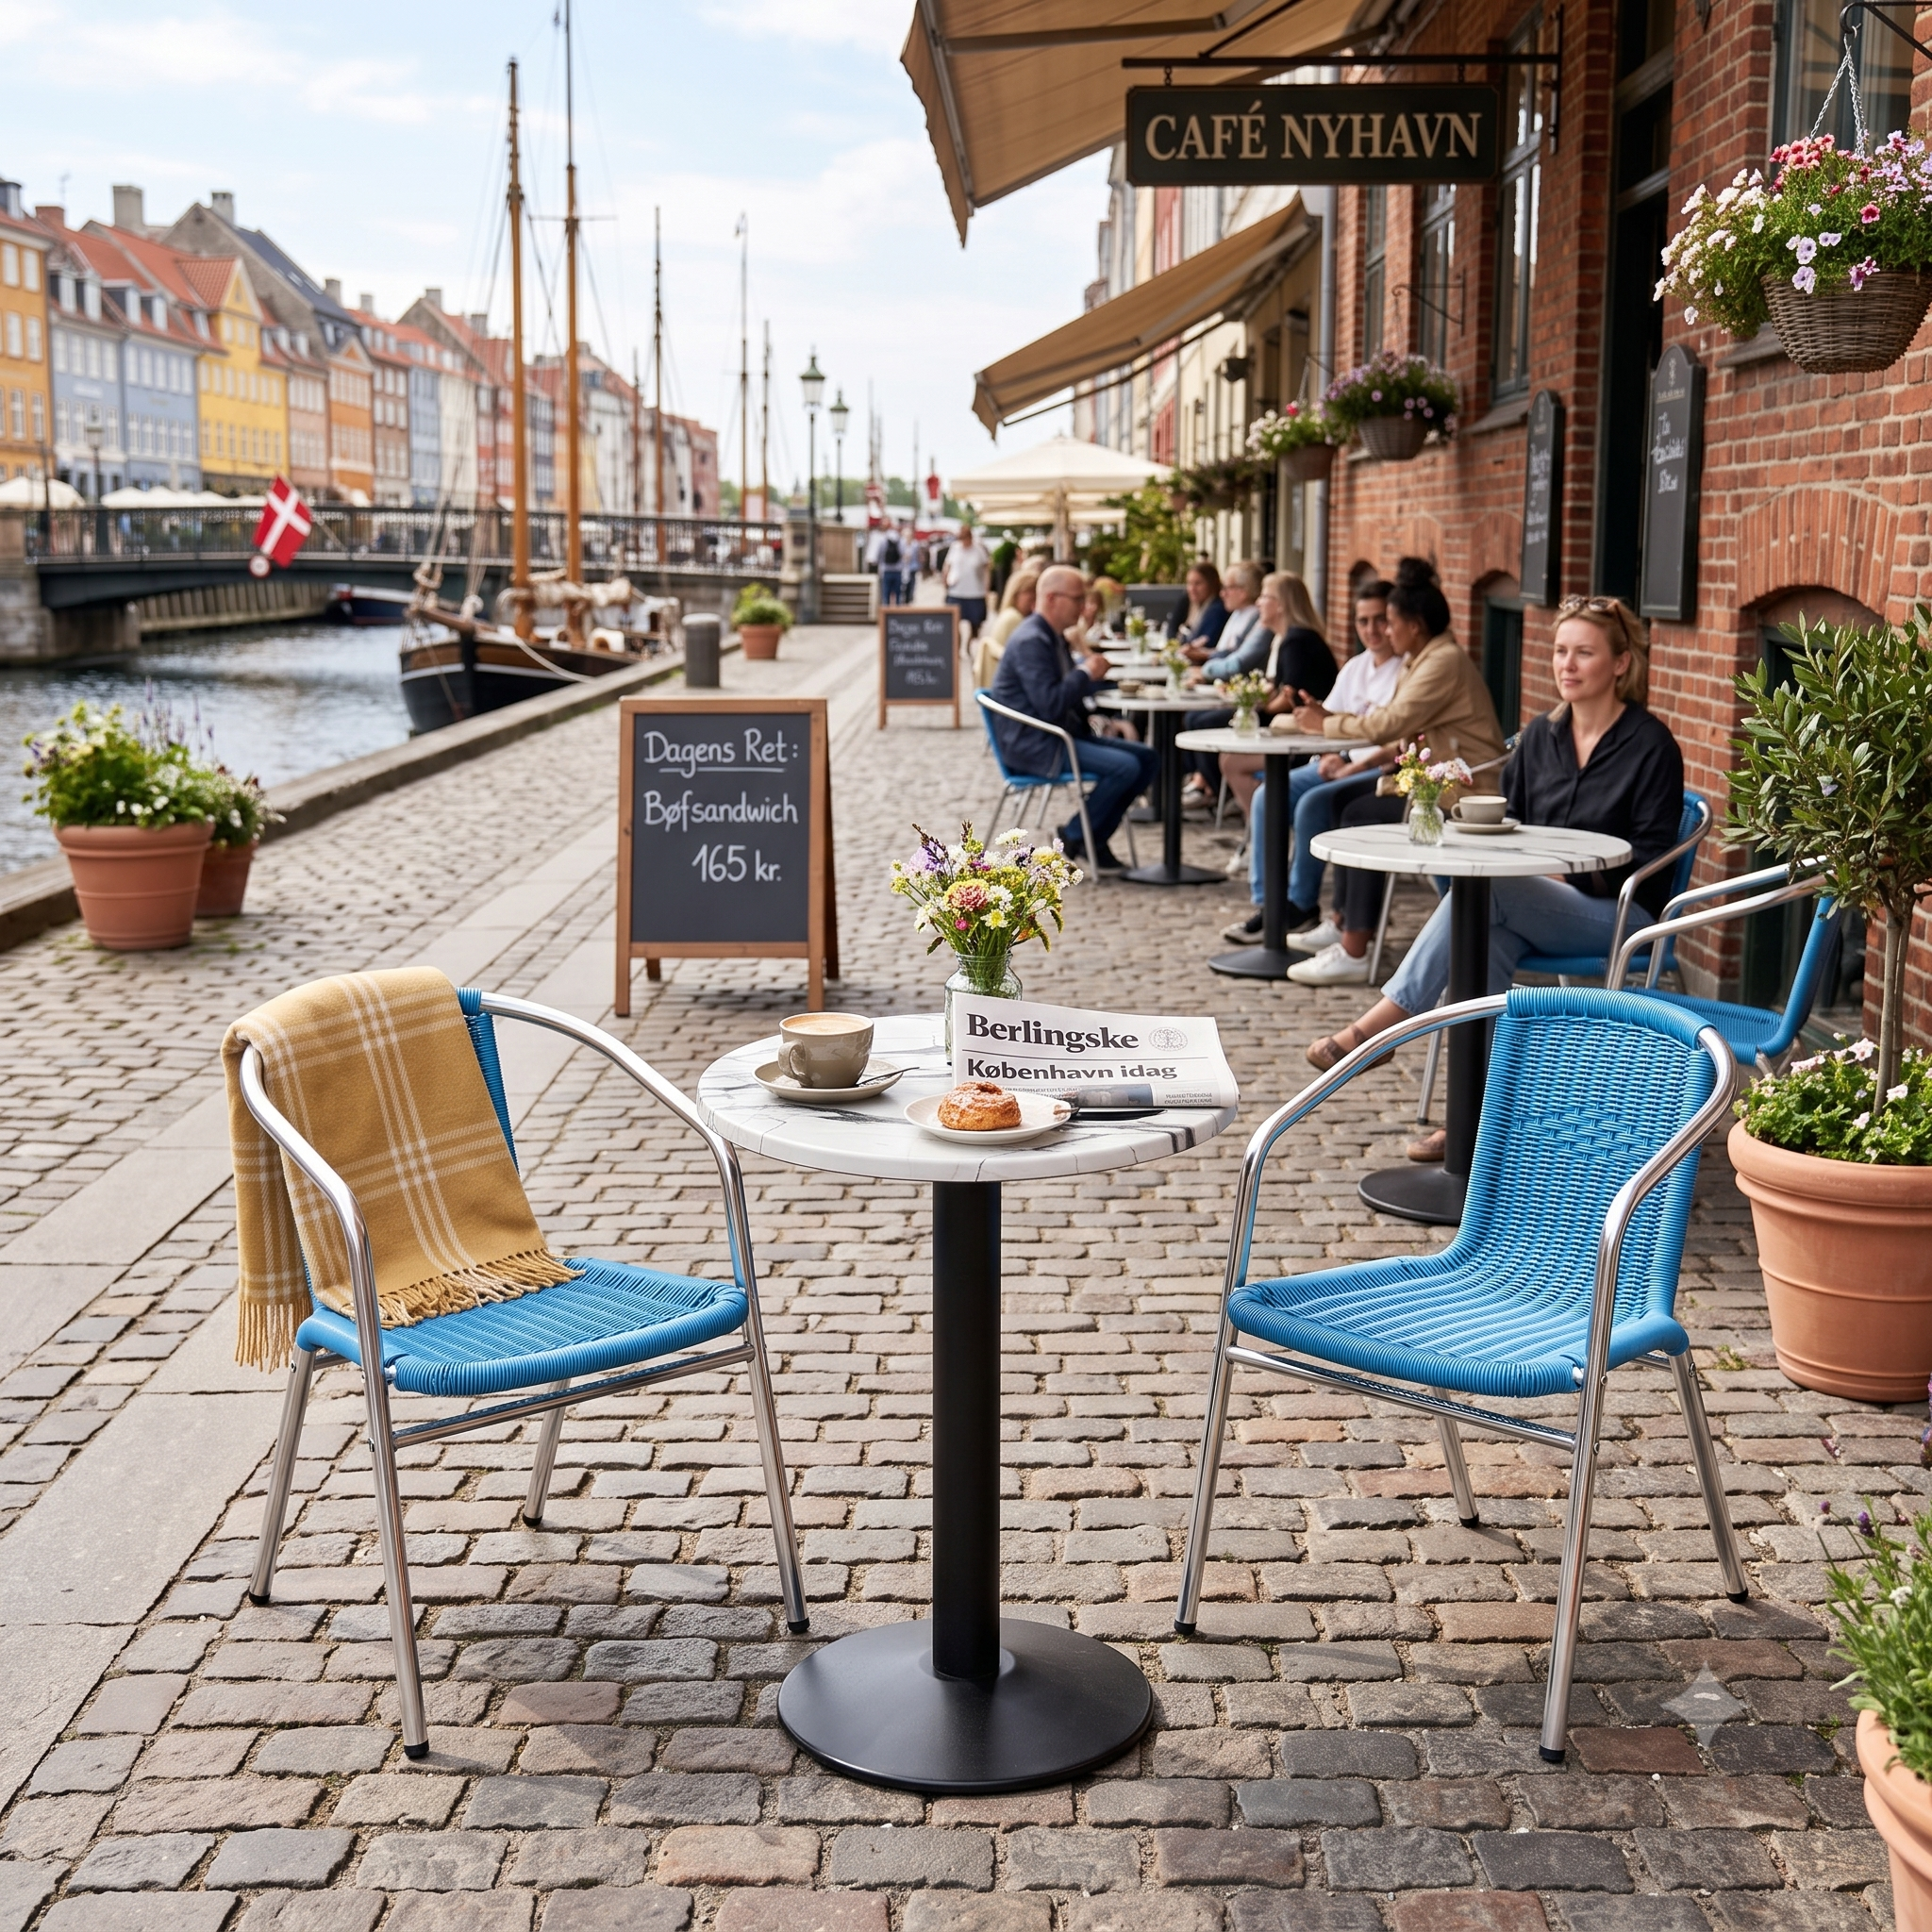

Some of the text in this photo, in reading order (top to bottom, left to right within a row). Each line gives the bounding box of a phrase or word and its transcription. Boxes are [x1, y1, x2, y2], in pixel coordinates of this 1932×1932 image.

[1144, 99, 1482, 161] CAFÉ NYHAVN
[643, 730, 736, 779] Dagens
[643, 790, 799, 832] Bøfsandwich
[691, 843, 782, 883] 165 kr.
[966, 1012, 1140, 1054] Berlingske
[967, 1058, 1178, 1080] København idag
